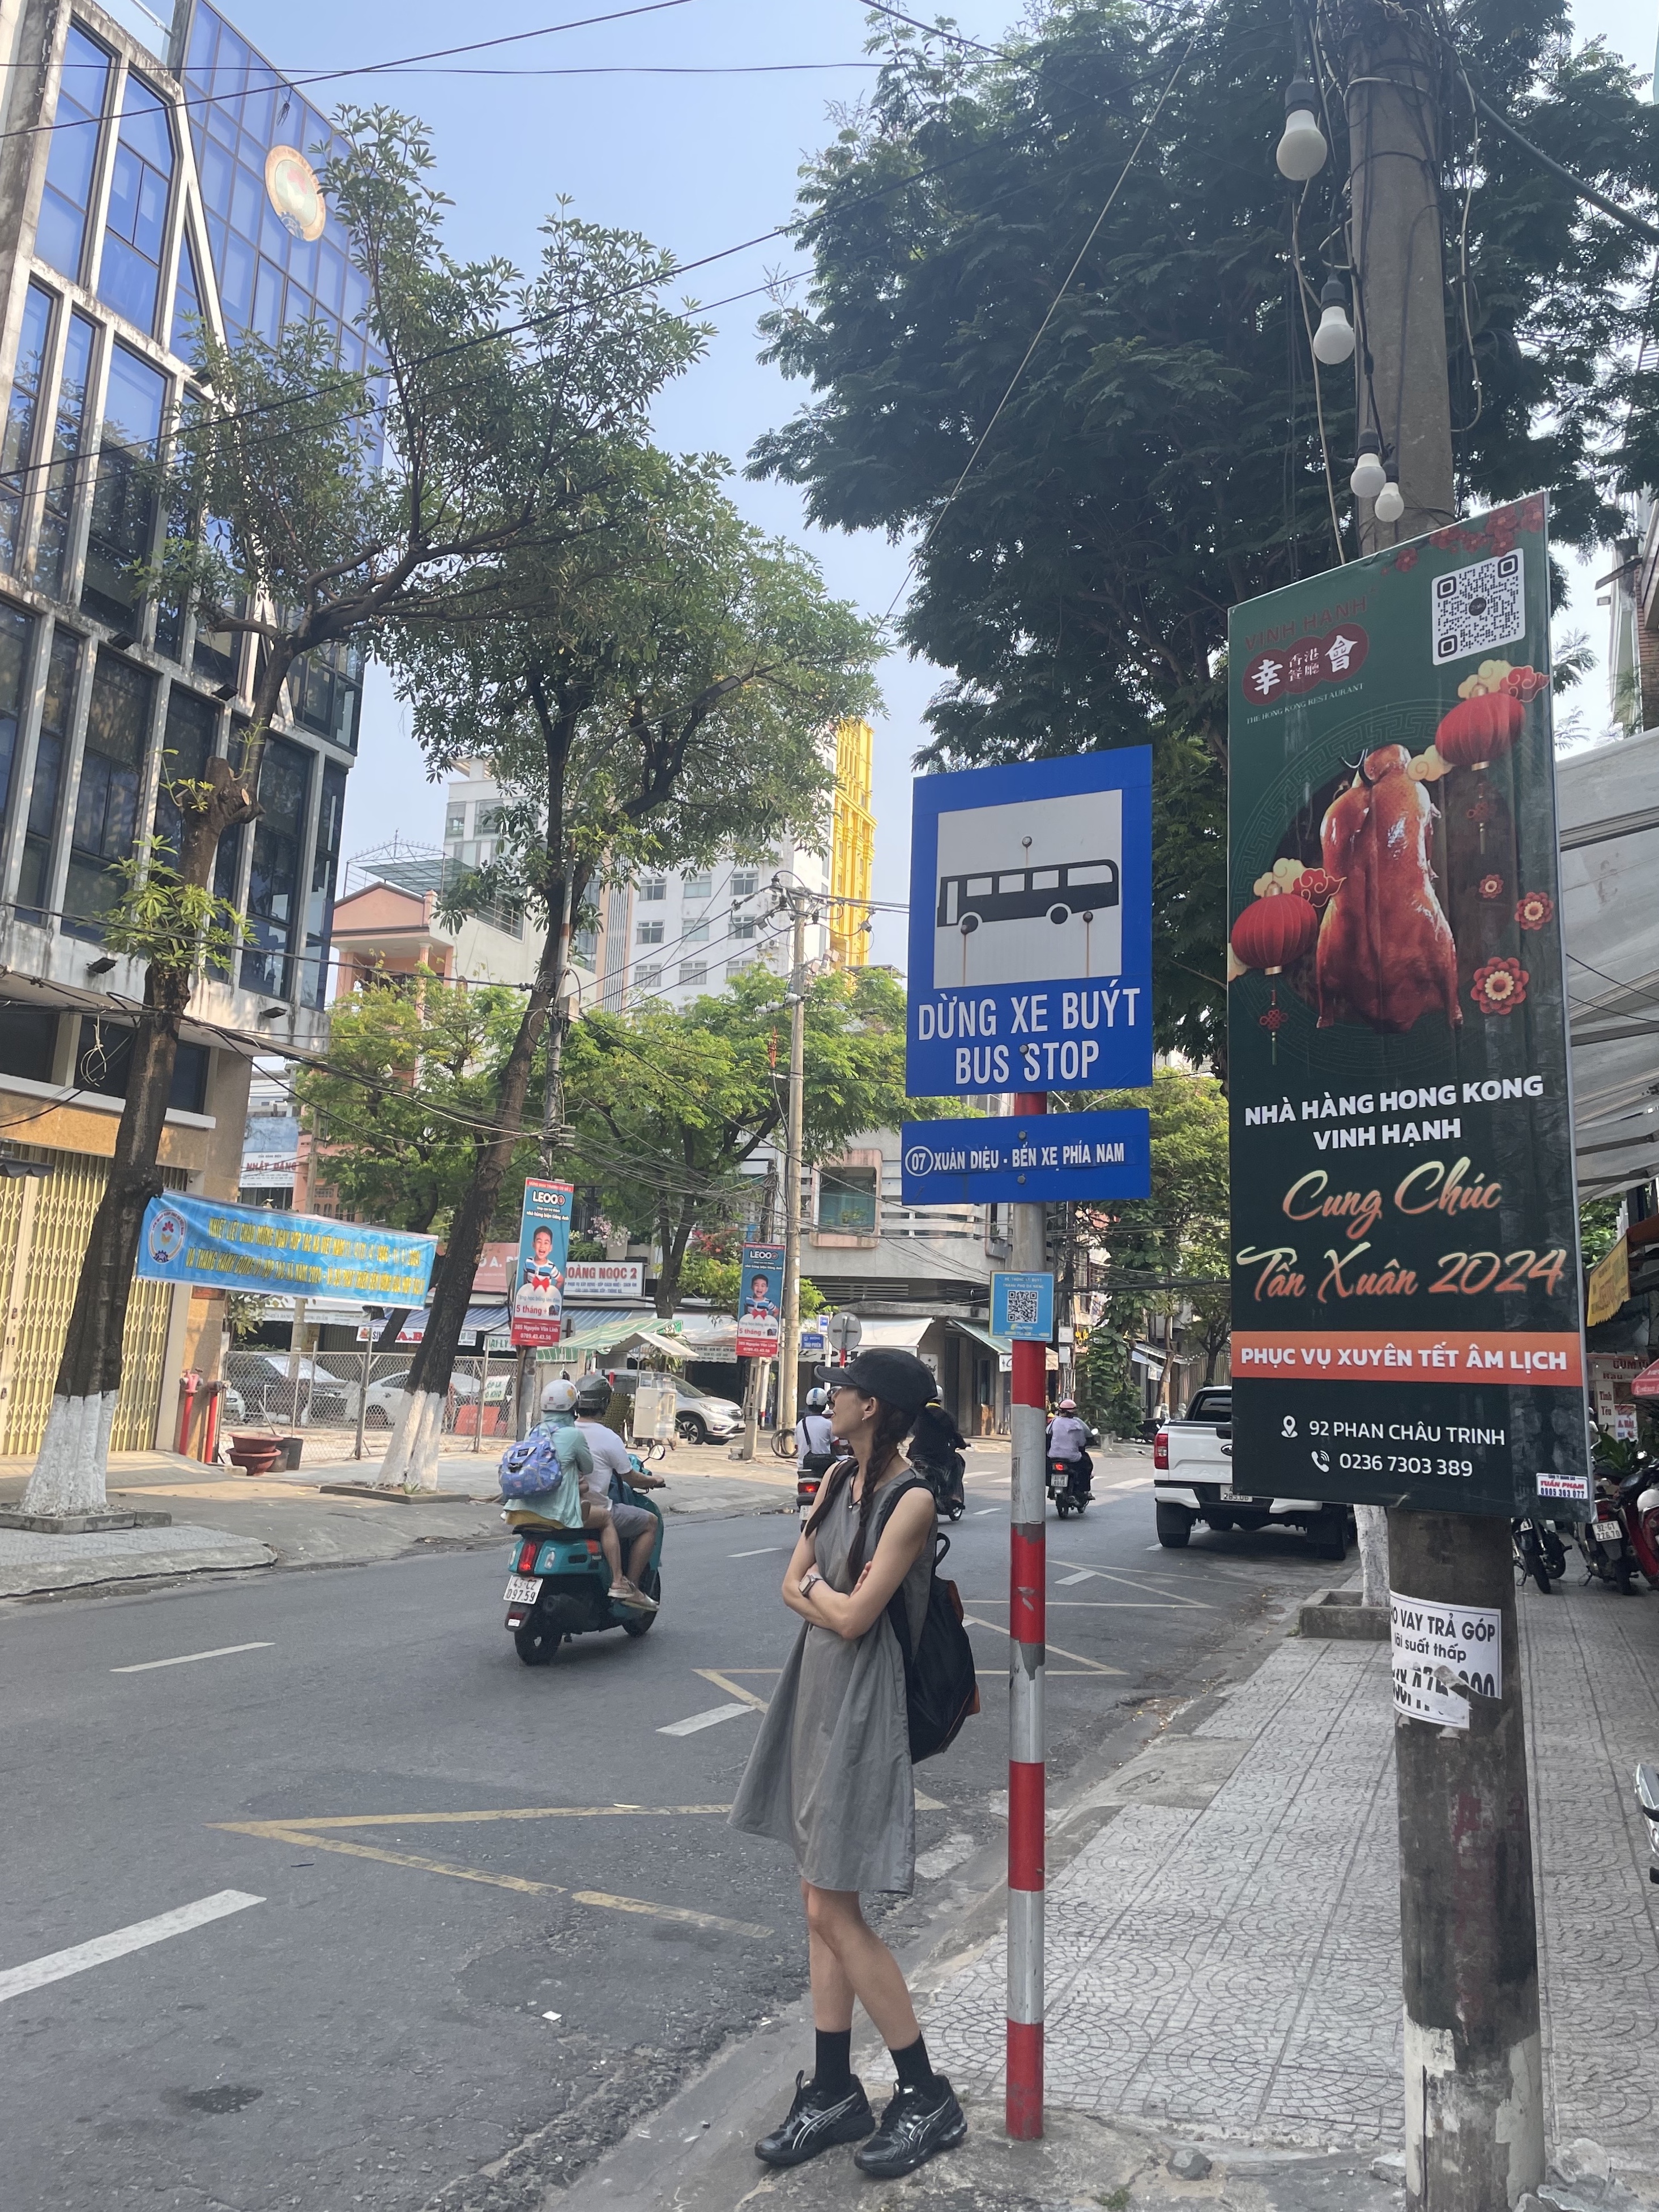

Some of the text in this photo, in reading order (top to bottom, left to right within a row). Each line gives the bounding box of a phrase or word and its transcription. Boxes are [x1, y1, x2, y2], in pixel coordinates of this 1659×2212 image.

[1245, 621, 1295, 650] VINH
[1325, 635, 1358, 672] 會
[1251, 659, 1283, 695] 幸
[1247, 683, 1364, 724] THE HONG KONG RESTAURANT
[918, 979, 1140, 1041] DỪNG XE BUÝT
[956, 1040, 1099, 1084] BUS STOP
[1245, 1075, 1543, 1126] NHÀ HÀNG HONG KONG
[1313, 1118, 1461, 1150] VINH HẠNH
[911, 1152, 926, 1171] 07
[933, 1147, 966, 1171] XUÂN
[970, 1145, 999, 1171] DIỆU
[1012, 1141, 1037, 1168] BẾN
[1063, 1140, 1091, 1165] PHÍA
[1096, 1143, 1124, 1163] NAM
[1283, 1156, 1502, 1239] Cung Chúc
[599, 1267, 627, 1281] NGỌC
[630, 1268, 637, 1279] 2
[1236, 1246, 1306, 1302] Tân
[1317, 1242, 1418, 1303] Xuân
[1428, 1249, 1567, 1297] 2024
[522, 1305, 542, 1316] tháng
[1241, 1341, 1567, 1374] PHỤC VỤ XUYÊN TẾT ÂM LỊCH
[1309, 1421, 1505, 1445] 92 PHAN CHÂU TRINH
[1340, 1453, 1473, 1477] 0236 7303 389
[506, 1588, 535, 1602] 097.59
[1401, 1609, 1495, 1642] VAY TRẢ GÓP
[1405, 1638, 1430, 1655] suất
[1434, 1643, 1466, 1663] thấp
